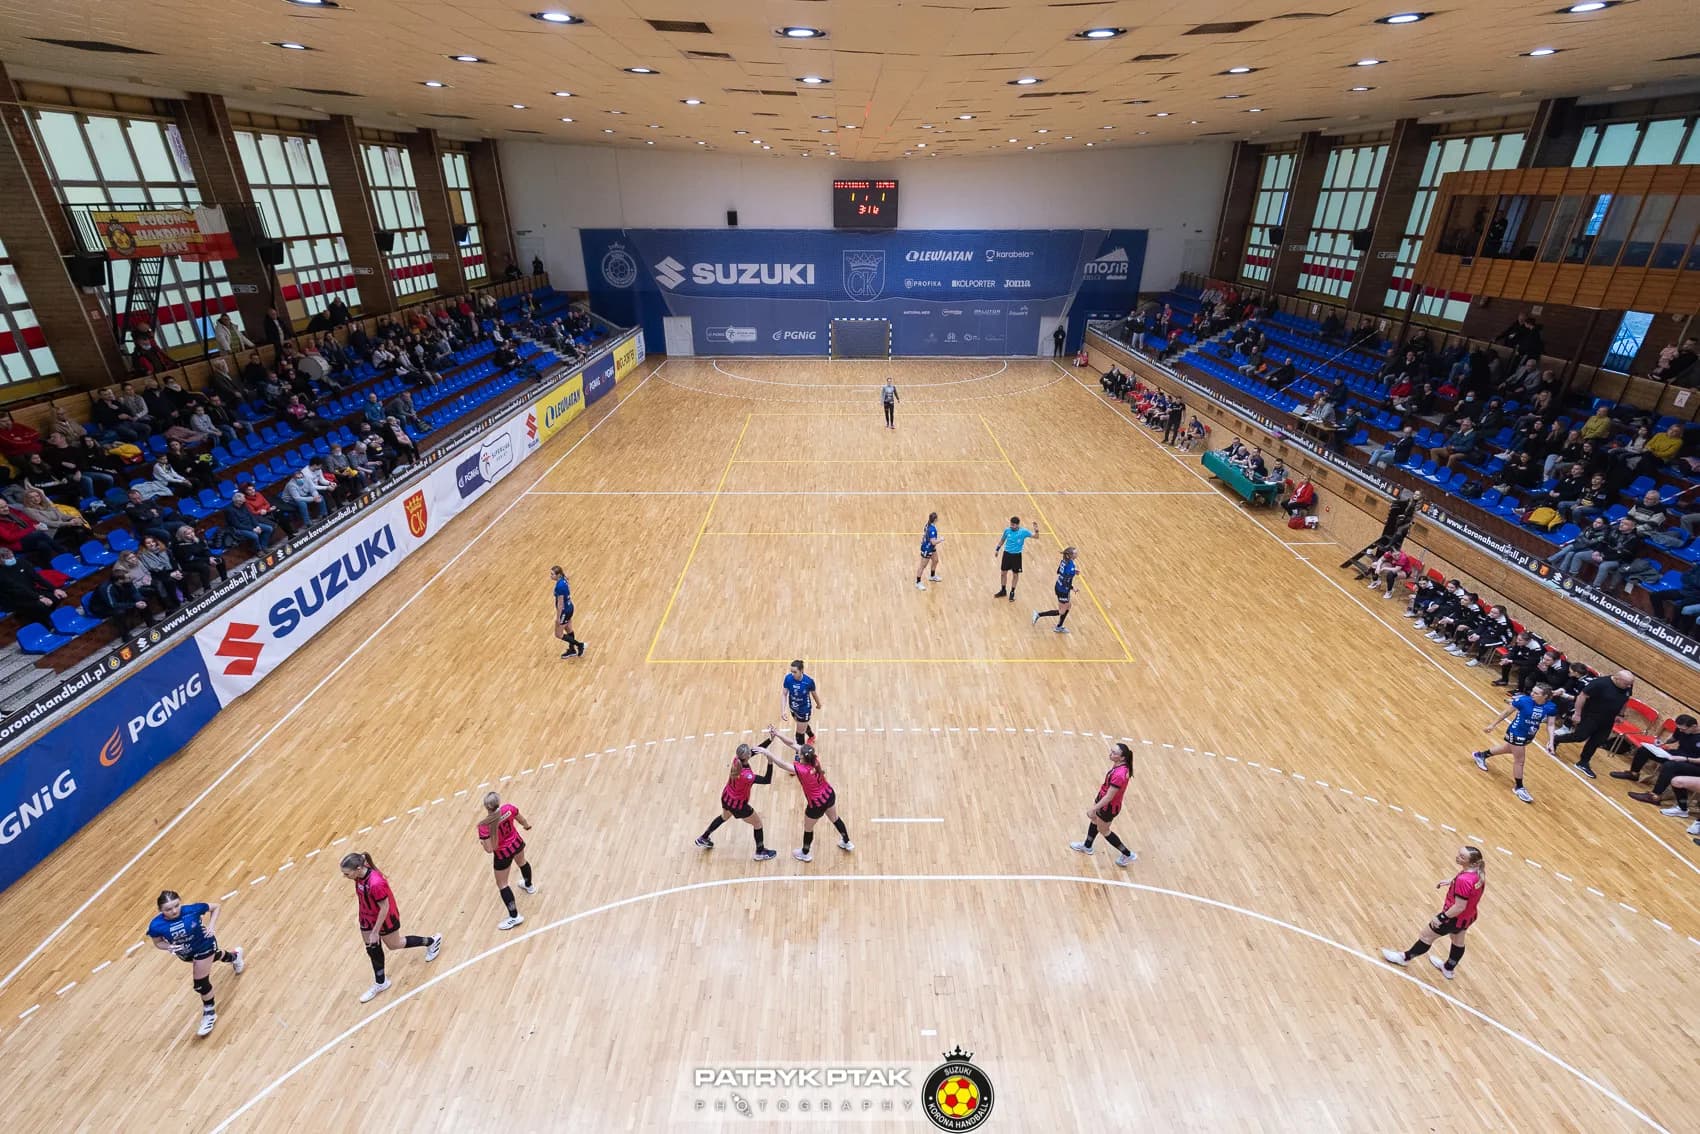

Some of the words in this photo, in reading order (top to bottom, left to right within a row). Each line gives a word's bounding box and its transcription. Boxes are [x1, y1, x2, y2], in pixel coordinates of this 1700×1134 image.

[919, 251, 974, 261] LEWIATAN
[692, 263, 815, 285] SUZUKI
[957, 280, 996, 288] KOLPORTER
[784, 331, 816, 340] PGNiG
[292, 502, 359, 549] www.koronahandball.pl
[410, 511, 426, 536] CK
[268, 523, 396, 639] SUZUKI
[127, 673, 203, 744] PGNiG
